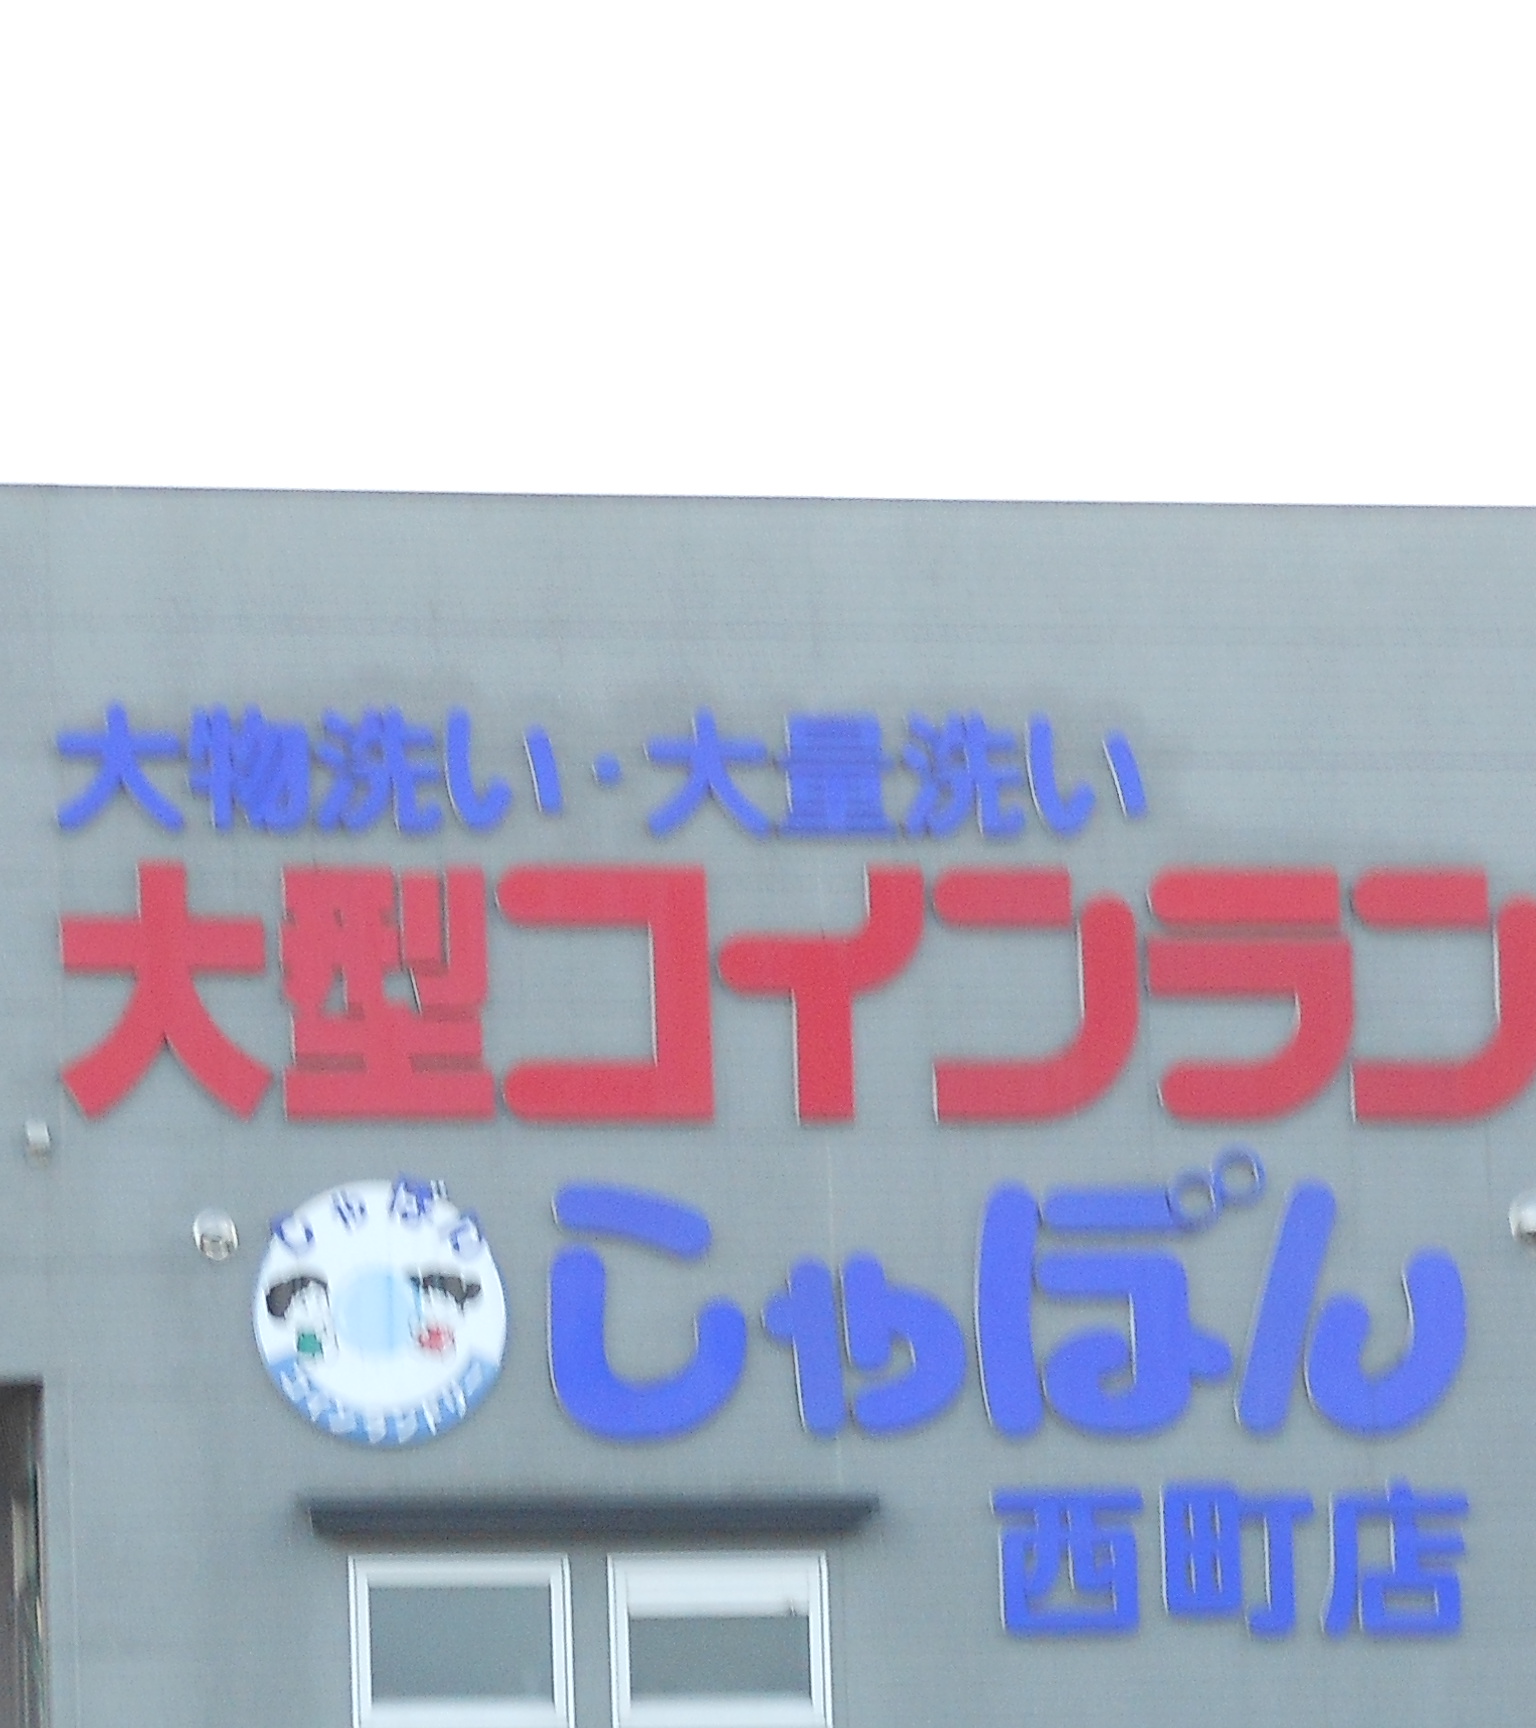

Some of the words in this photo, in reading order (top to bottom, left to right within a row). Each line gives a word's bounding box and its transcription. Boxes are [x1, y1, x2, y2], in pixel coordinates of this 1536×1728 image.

[57, 701, 1148, 840] 大物洗い・大量洗い
[990, 1478, 1469, 1638] 西町店
